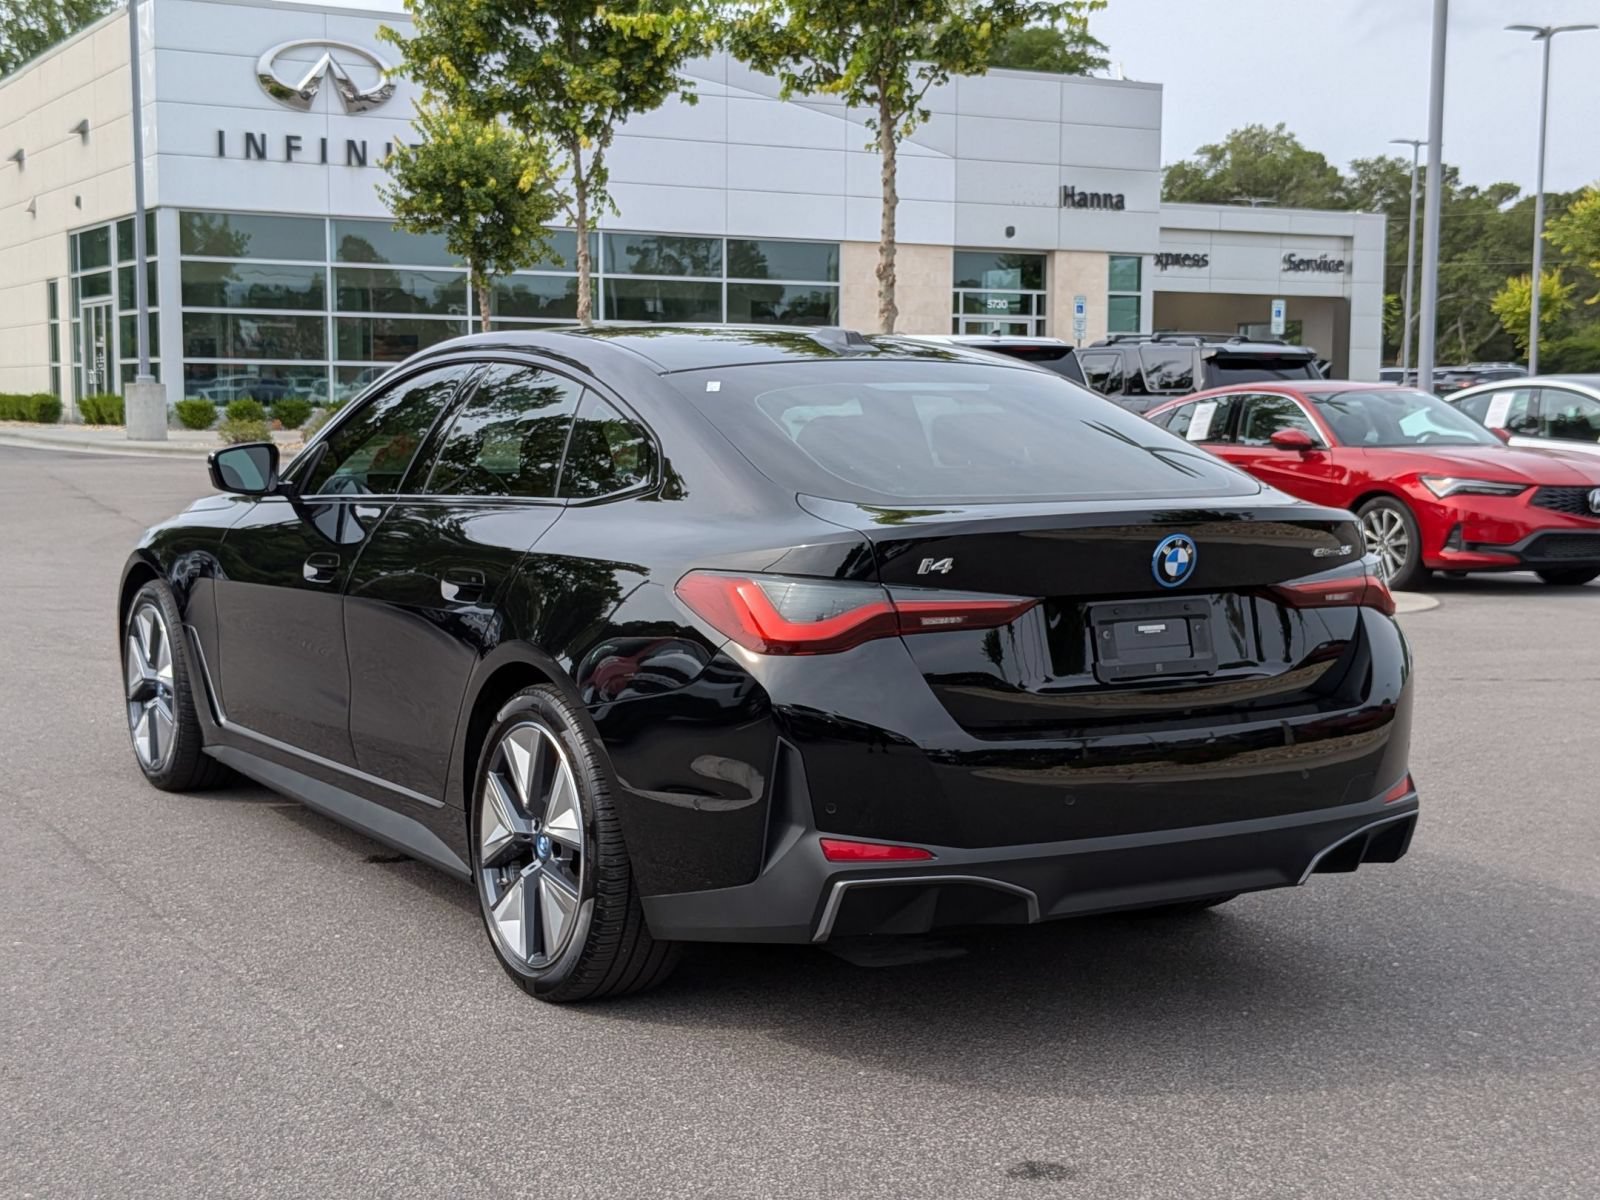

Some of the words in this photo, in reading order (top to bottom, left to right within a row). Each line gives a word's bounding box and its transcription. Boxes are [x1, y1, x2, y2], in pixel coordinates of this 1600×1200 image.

[217, 129, 424, 168] INFINI
[1061, 185, 1125, 210] Hanna
[1154, 253, 1209, 271] xpress
[1283, 253, 1345, 272] Service
[987, 299, 1009, 309] 5730
[917, 557, 954, 574] i4
